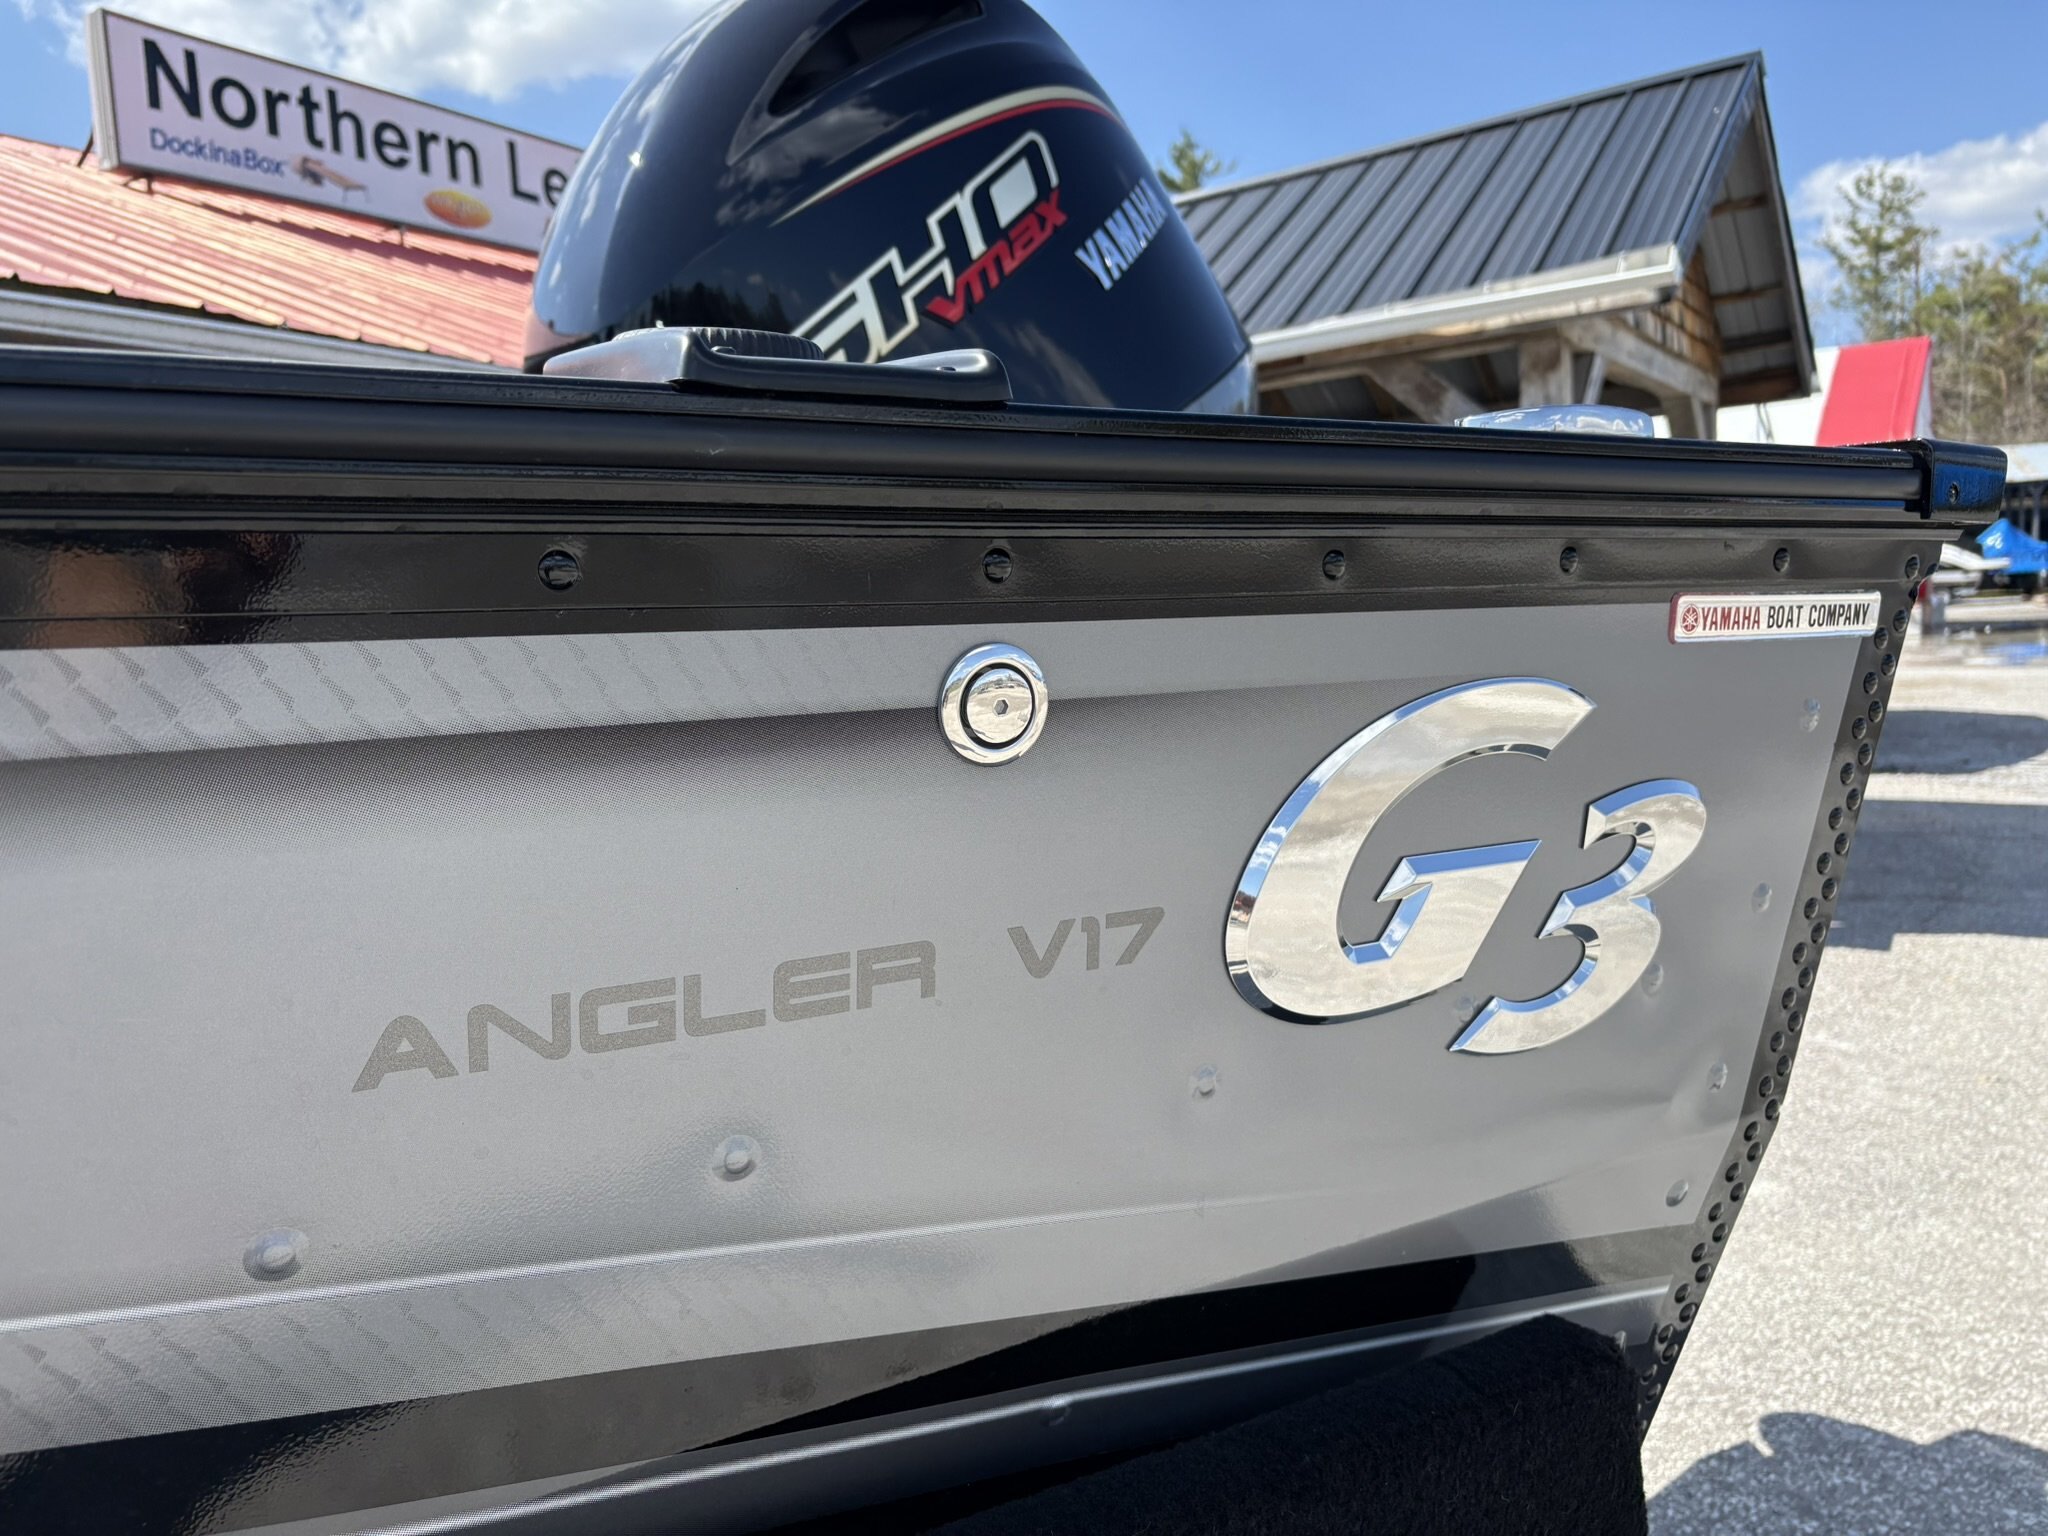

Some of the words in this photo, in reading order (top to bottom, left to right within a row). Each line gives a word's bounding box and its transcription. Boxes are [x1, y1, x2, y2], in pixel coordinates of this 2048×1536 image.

[142, 39, 481, 186] Northern
[1074, 177, 1168, 291] YAMAHA
[1701, 606, 1761, 631] YAMAHA
[1767, 604, 1804, 629] BOAT
[1808, 603, 1870, 628] COMPANY
[1225, 676, 1707, 1056] G3
[351, 939, 937, 1092] ANGLER
[1006, 906, 1165, 979] V17
